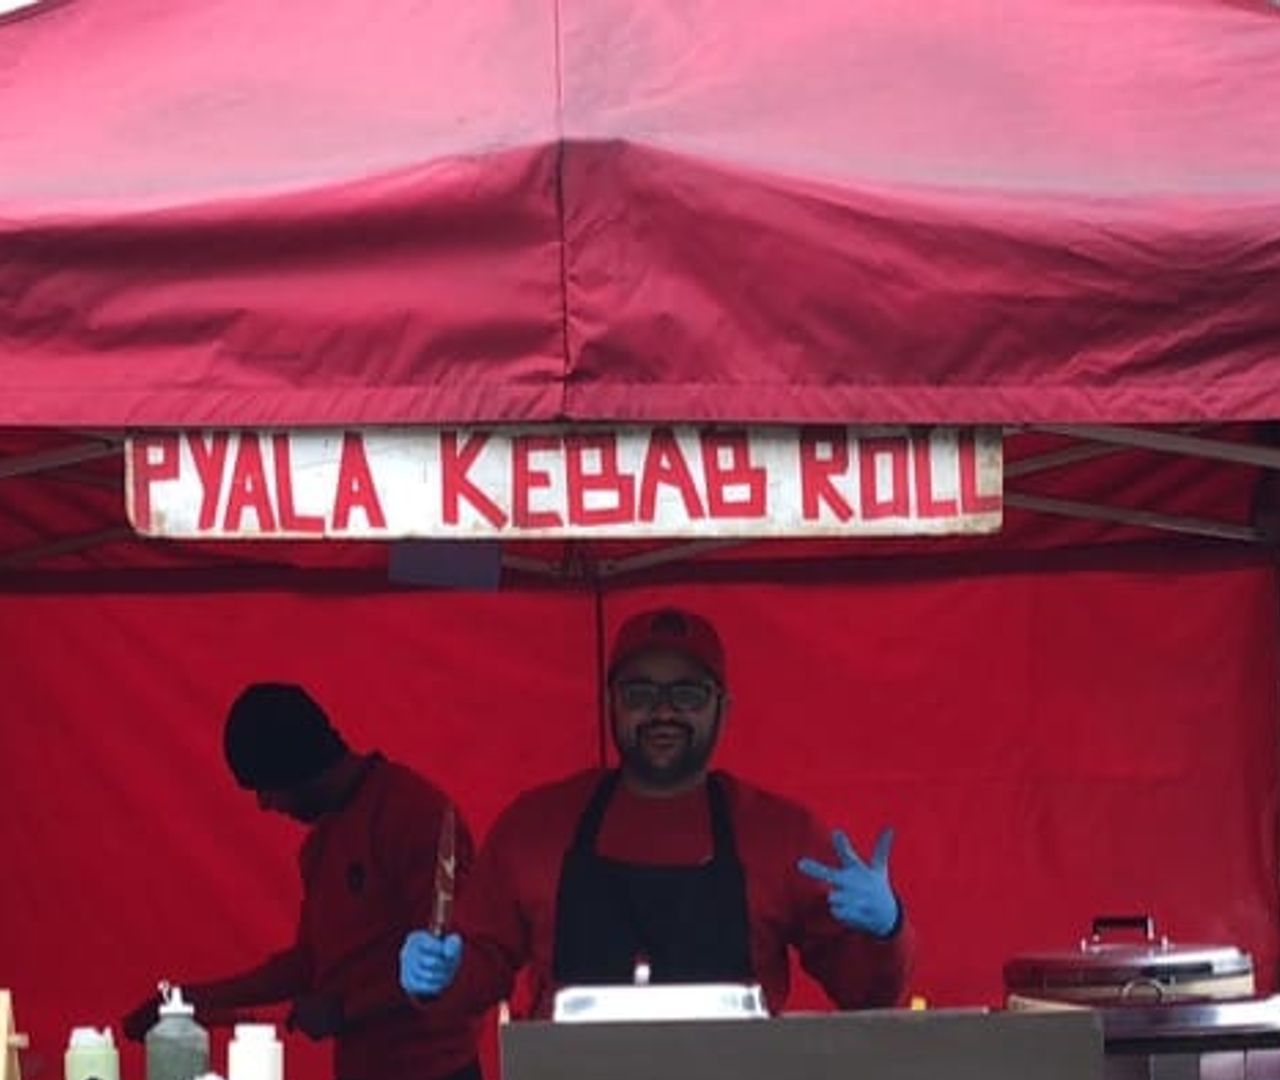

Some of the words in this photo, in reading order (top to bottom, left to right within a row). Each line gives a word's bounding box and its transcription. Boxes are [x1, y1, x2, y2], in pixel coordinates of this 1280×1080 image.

[134, 430, 387, 533] PYALA
[440, 428, 767, 532] KEBAB
[800, 428, 1001, 525] ROLL
